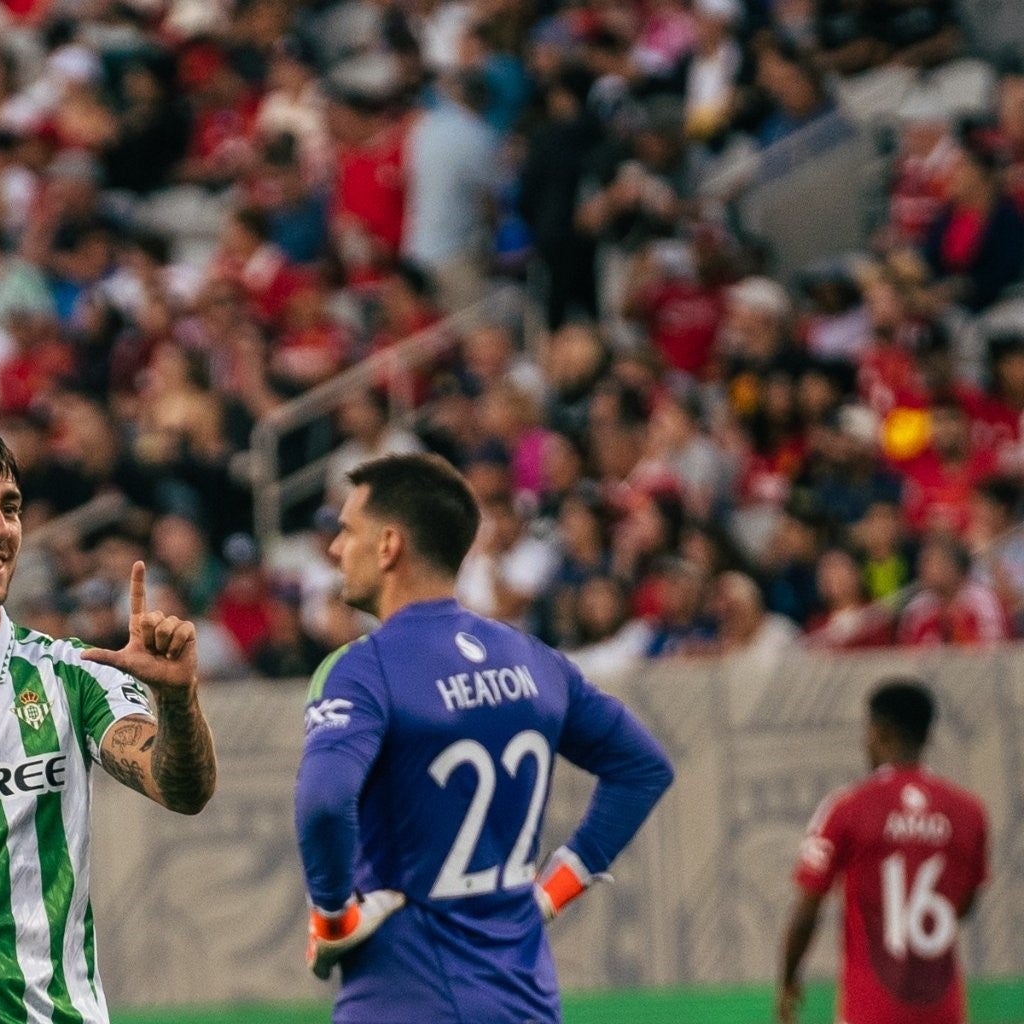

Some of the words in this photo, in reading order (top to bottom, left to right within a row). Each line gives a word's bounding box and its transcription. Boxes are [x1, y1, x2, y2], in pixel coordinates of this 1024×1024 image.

[436, 664, 539, 712] HEATON
[427, 729, 551, 898] 22
[881, 853, 955, 957] 16
